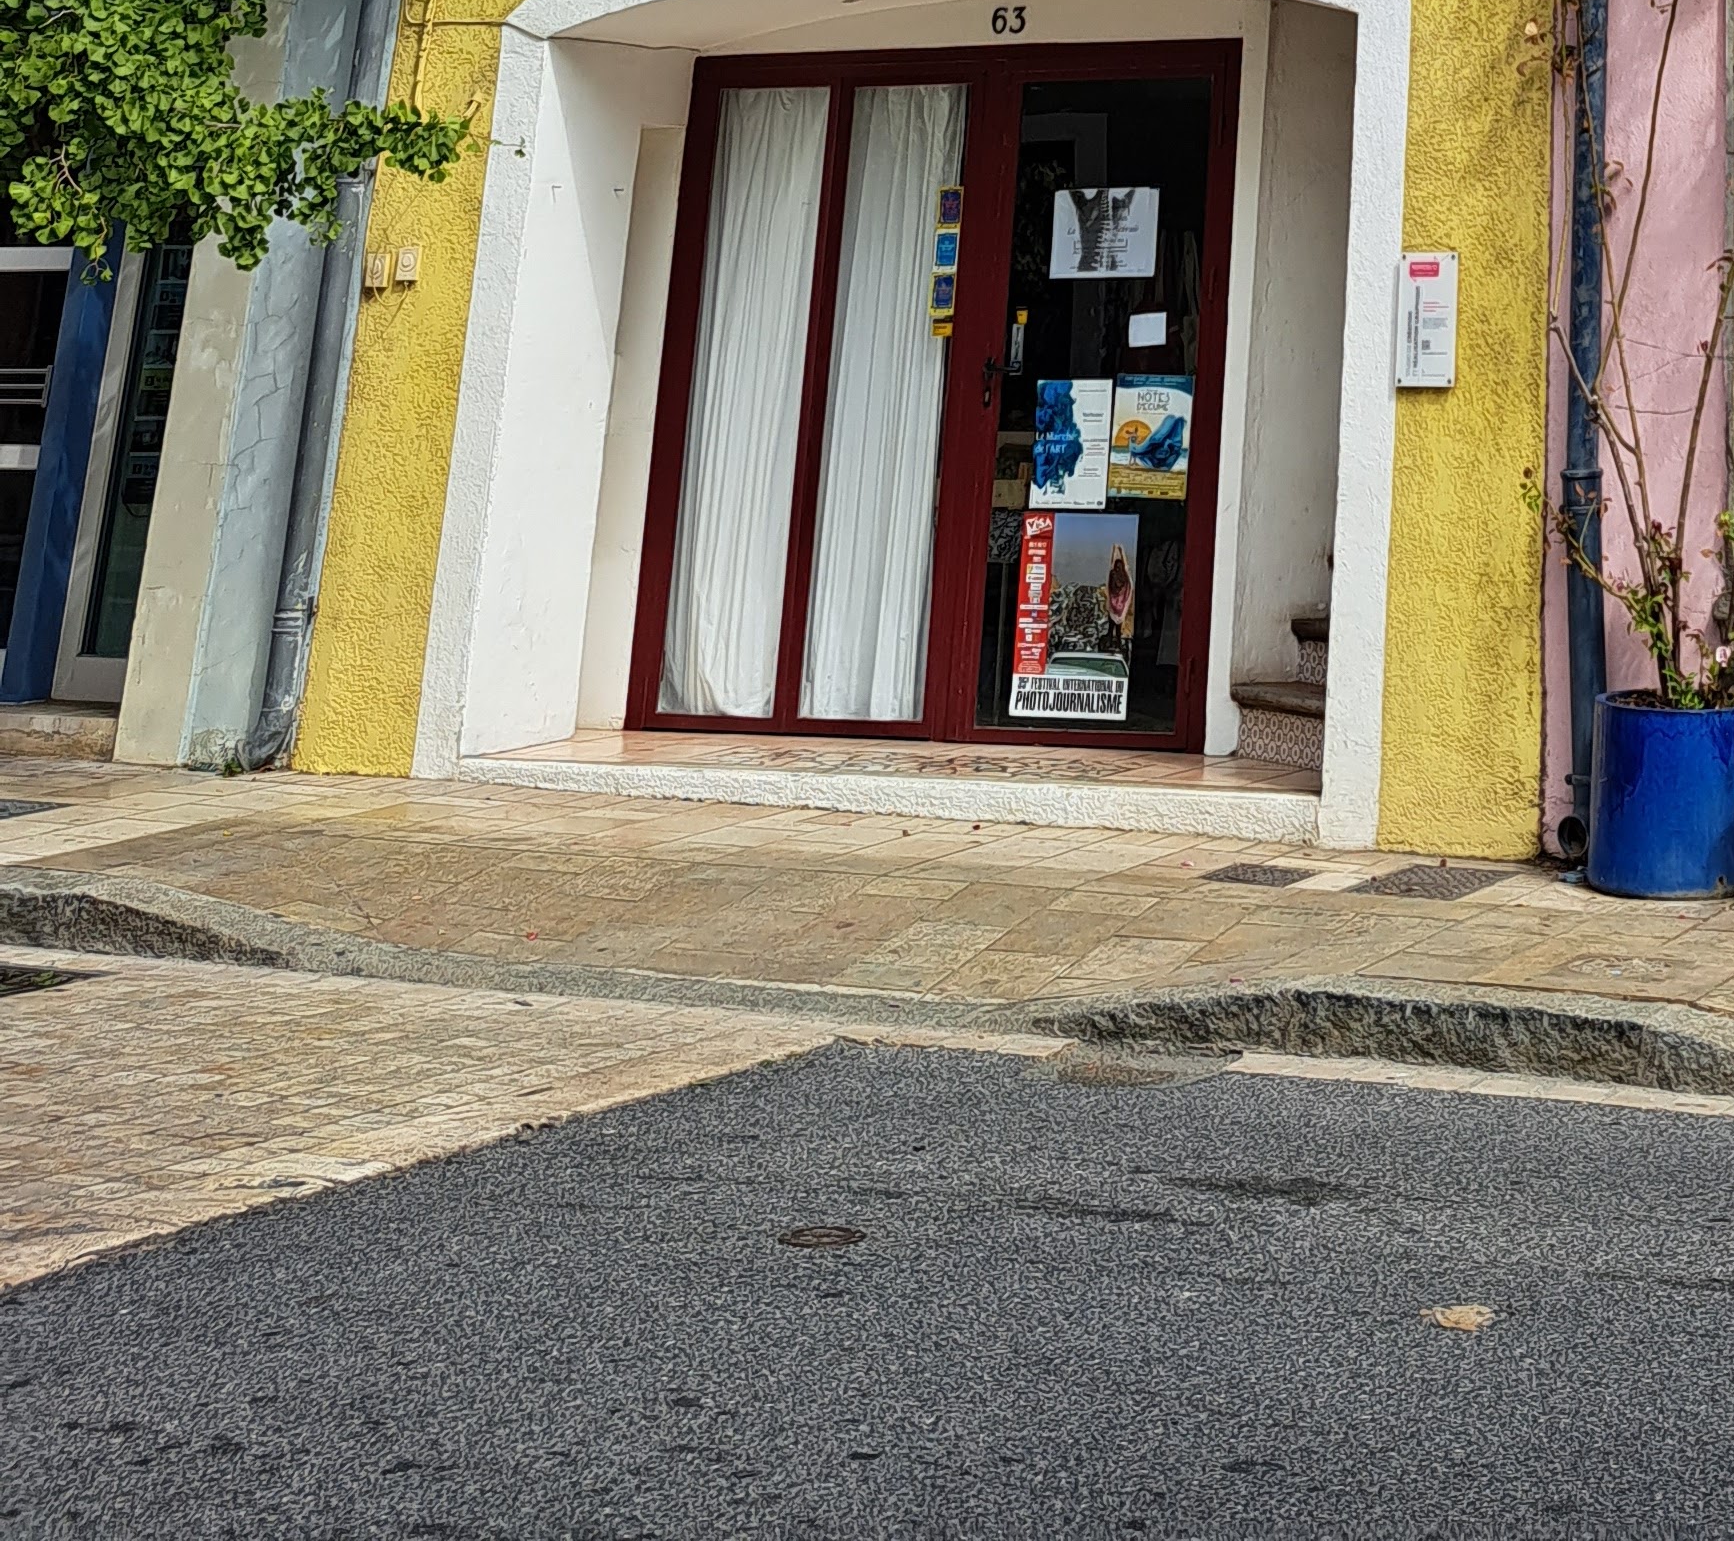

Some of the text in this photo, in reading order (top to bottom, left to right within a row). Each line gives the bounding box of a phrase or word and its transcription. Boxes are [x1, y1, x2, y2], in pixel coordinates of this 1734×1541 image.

[991, 6, 1027, 35] 63
[1030, 677, 1060, 691] FESTIVAL
[1062, 678, 1114, 693] INTERNATIONAL
[1014, 691, 1123, 714] PHOTOJOURNALISME
